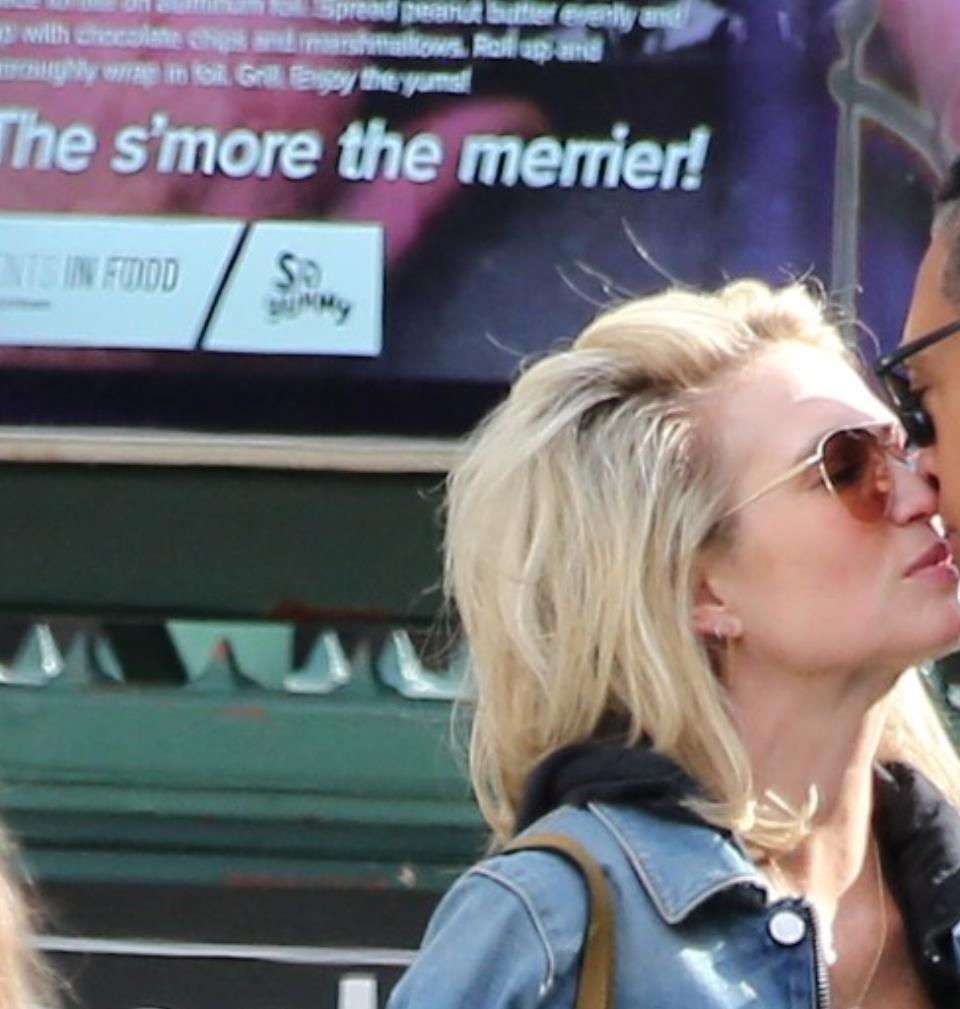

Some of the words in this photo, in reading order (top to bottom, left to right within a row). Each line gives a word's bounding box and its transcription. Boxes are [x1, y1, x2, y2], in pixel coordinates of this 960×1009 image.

[401, 0, 482, 26] peanut
[487, 0, 557, 25] butter
[560, 3, 637, 33] evenly
[638, 2, 690, 30] and
[22, 24, 71, 45] with
[75, 26, 182, 48] chocolate
[187, 29, 246, 53] chips
[252, 29, 297, 51] and
[472, 31, 519, 58] Roll
[519, 38, 553, 66] up
[554, 35, 604, 62] and
[102, 63, 161, 89] wrap
[164, 64, 189, 86] in
[288, 65, 358, 95] Enjoy
[360, 66, 399, 92] the
[0, 107, 96, 173] The
[110, 111, 323, 179] s'more
[338, 118, 443, 182] the
[457, 122, 712, 191] merrier!
[62, 255, 98, 289] IN
[101, 256, 179, 293] FOOD
